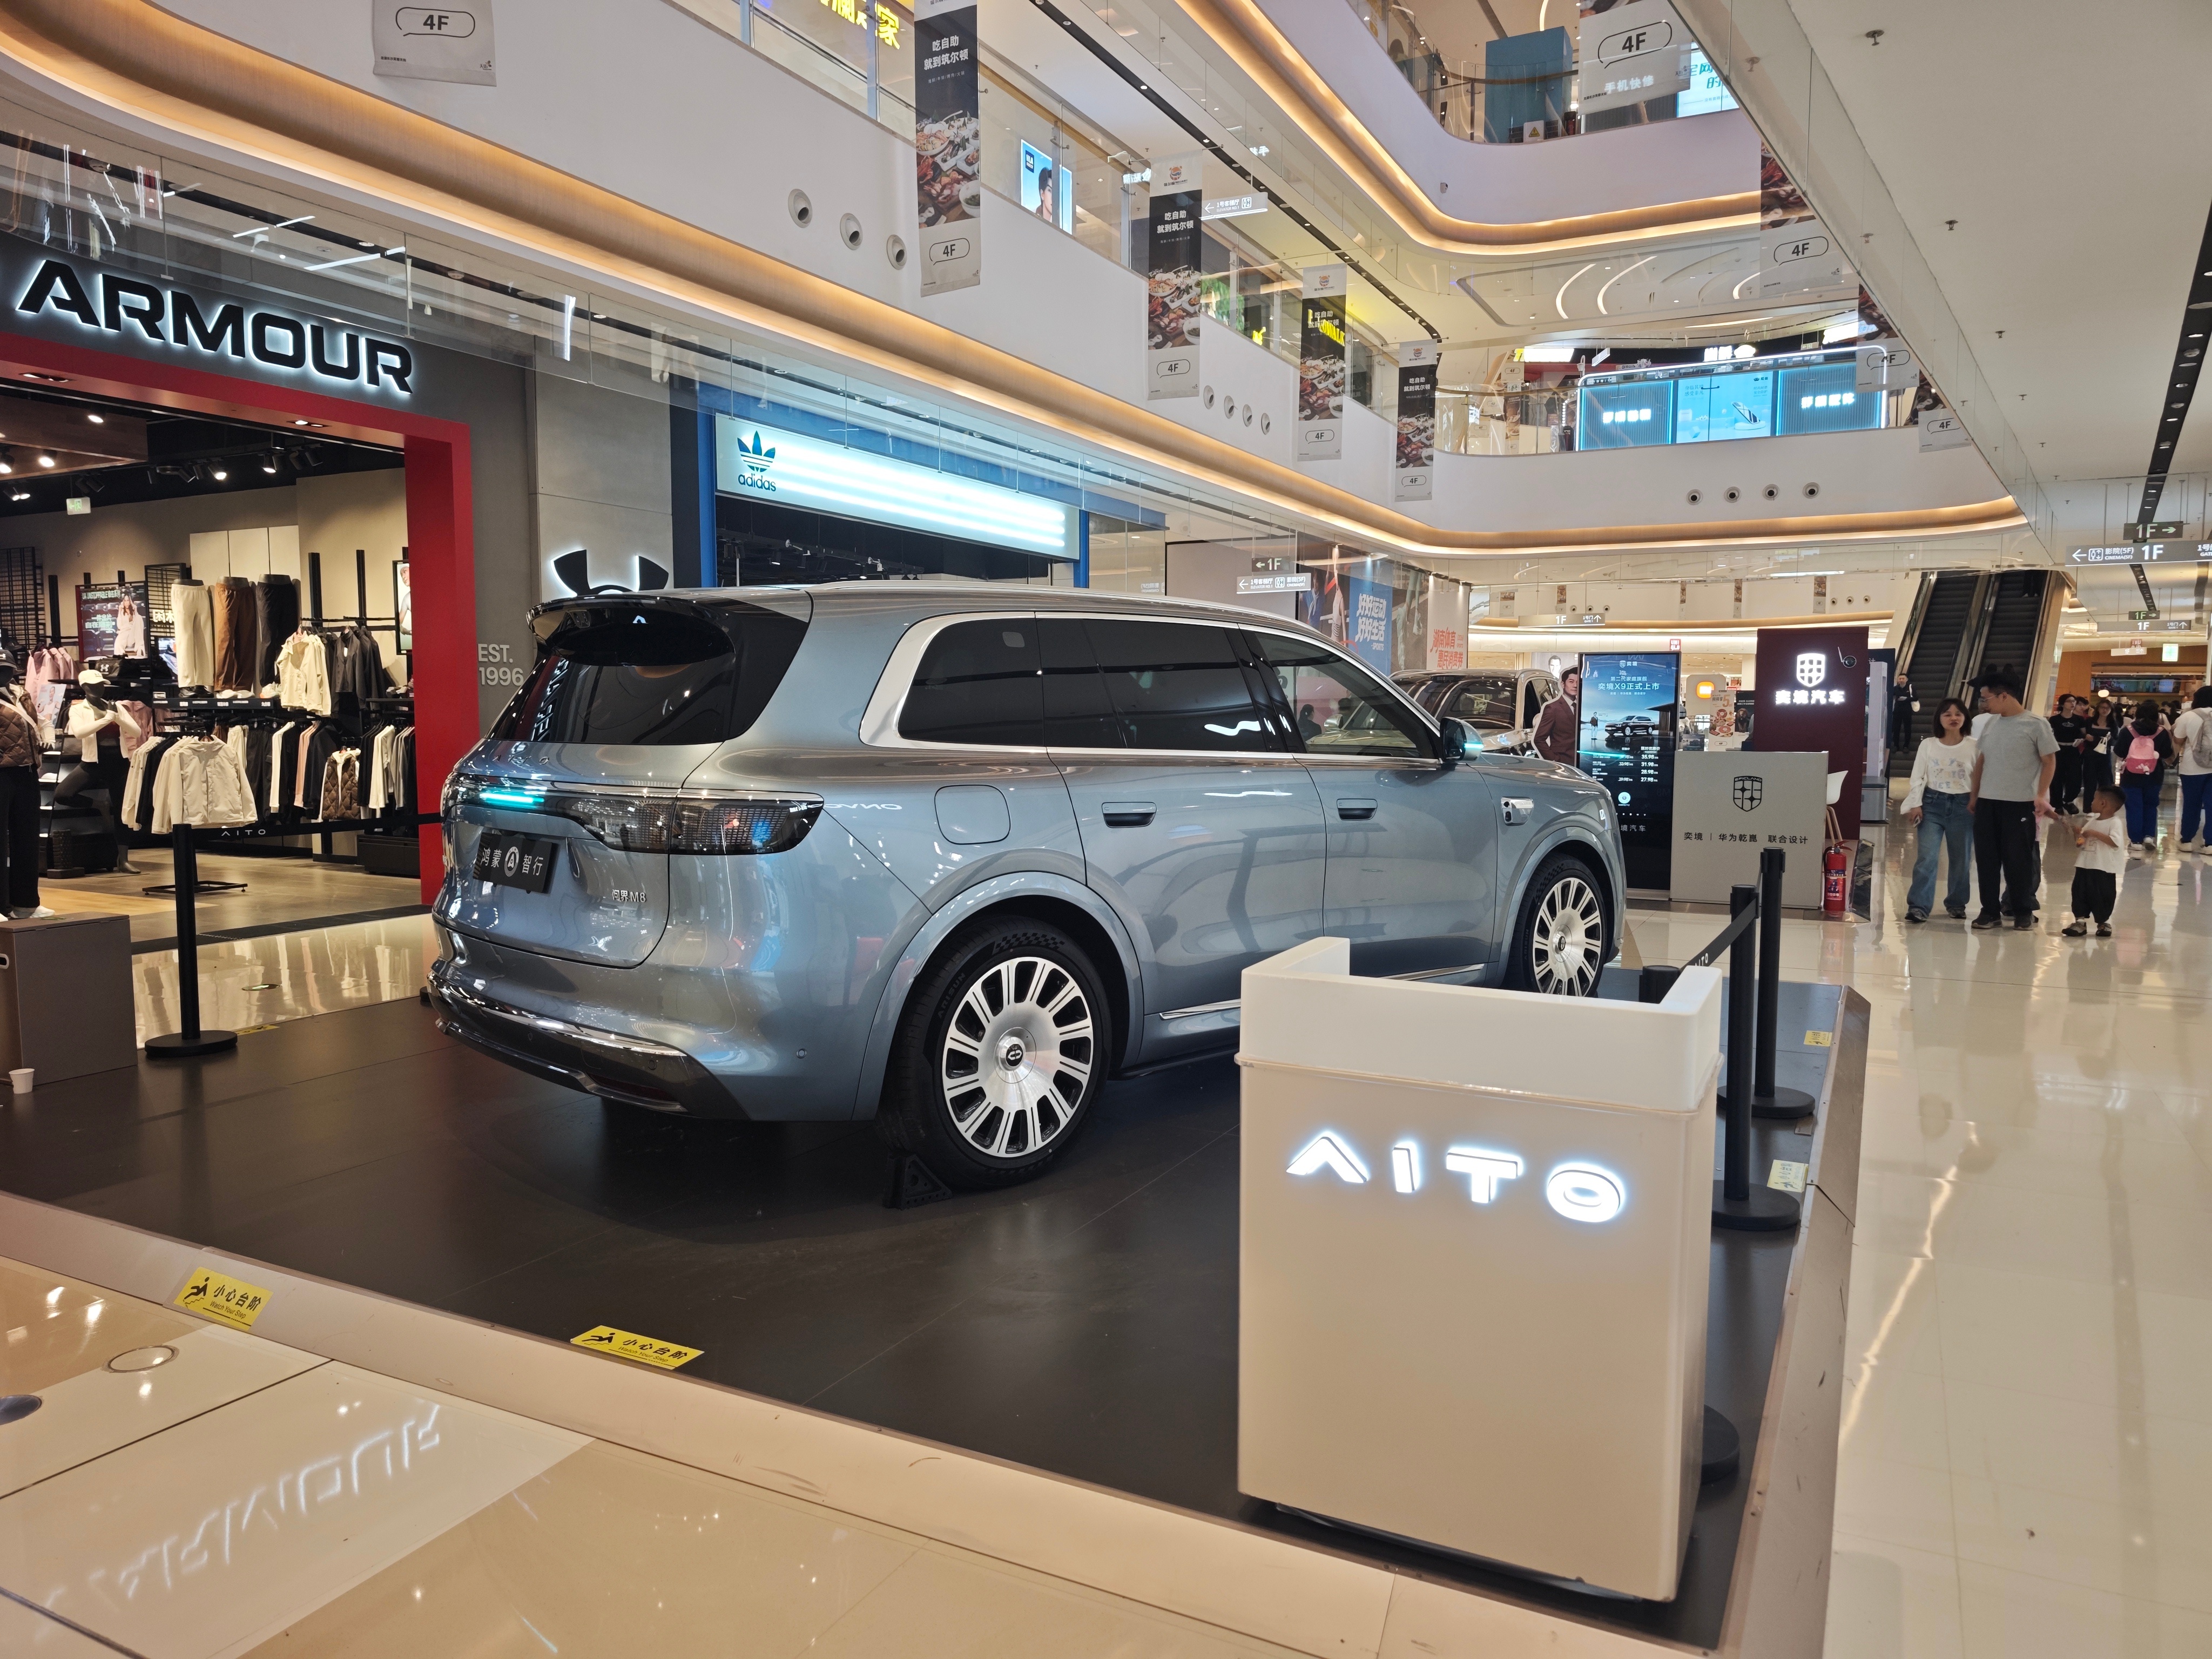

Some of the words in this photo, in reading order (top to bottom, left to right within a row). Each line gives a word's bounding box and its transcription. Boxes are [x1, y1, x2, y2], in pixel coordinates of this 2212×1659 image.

[423, 14, 449, 31] 4F
[932, 35, 959, 51] 吃自助
[1622, 32, 1647, 52] 4F
[923, 49, 969, 70] 就到筑尔顿
[1604, 75, 1654, 94] 手机快修
[1164, 211, 1186, 220] 吃自助
[1157, 220, 1194, 234] 就到筑尔顿
[943, 244, 955, 257] 4F
[1791, 242, 1810, 257] 4F
[16, 259, 413, 395] ARMOUR
[1881, 354, 1896, 363] 4F
[1168, 363, 1178, 373] 4F
[1939, 421, 1951, 429] 4F
[738, 473, 777, 492] adidas
[2136, 524, 2157, 538] 1F
[2105, 547, 2134, 555] 影院(5F)
[2142, 544, 2164, 560] 1F
[1267, 558, 1282, 570] 1F
[1356, 593, 1387, 619] 好好运动
[1555, 615, 1567, 624] 1F
[2135, 611, 2147, 620] 1F
[1354, 616, 1387, 643] 好好生活
[2137, 622, 2150, 631] 1F
[1430, 626, 1456, 654] 湖南体育
[478, 643, 513, 663] EST.
[479, 666, 524, 686] 1996
[1597, 683, 1660, 691] 奕境X9正式上市
[1775, 690, 1845, 704] 奕境汽车
[1684, 832, 1703, 840] 奕境
[1718, 833, 1758, 842] 华为乾崑
[1768, 834, 1809, 844] 联合设计
[481, 847, 502, 868] 鸿蒙
[522, 854, 544, 876] 智行
[612, 889, 646, 903] 问界M8
[938, 972, 966, 1020] ARISUN
[1286, 1135, 1622, 1223] AITO
[214, 1284, 262, 1312] 小心台阶
[210, 1300, 225, 1311] Watch
[225, 1305, 235, 1316] Your
[234, 1310, 246, 1319] Step
[618, 1346, 638, 1354] Watch
[653, 1355, 669, 1363] Step
[623, 1339, 687, 1360] 小心台阶
